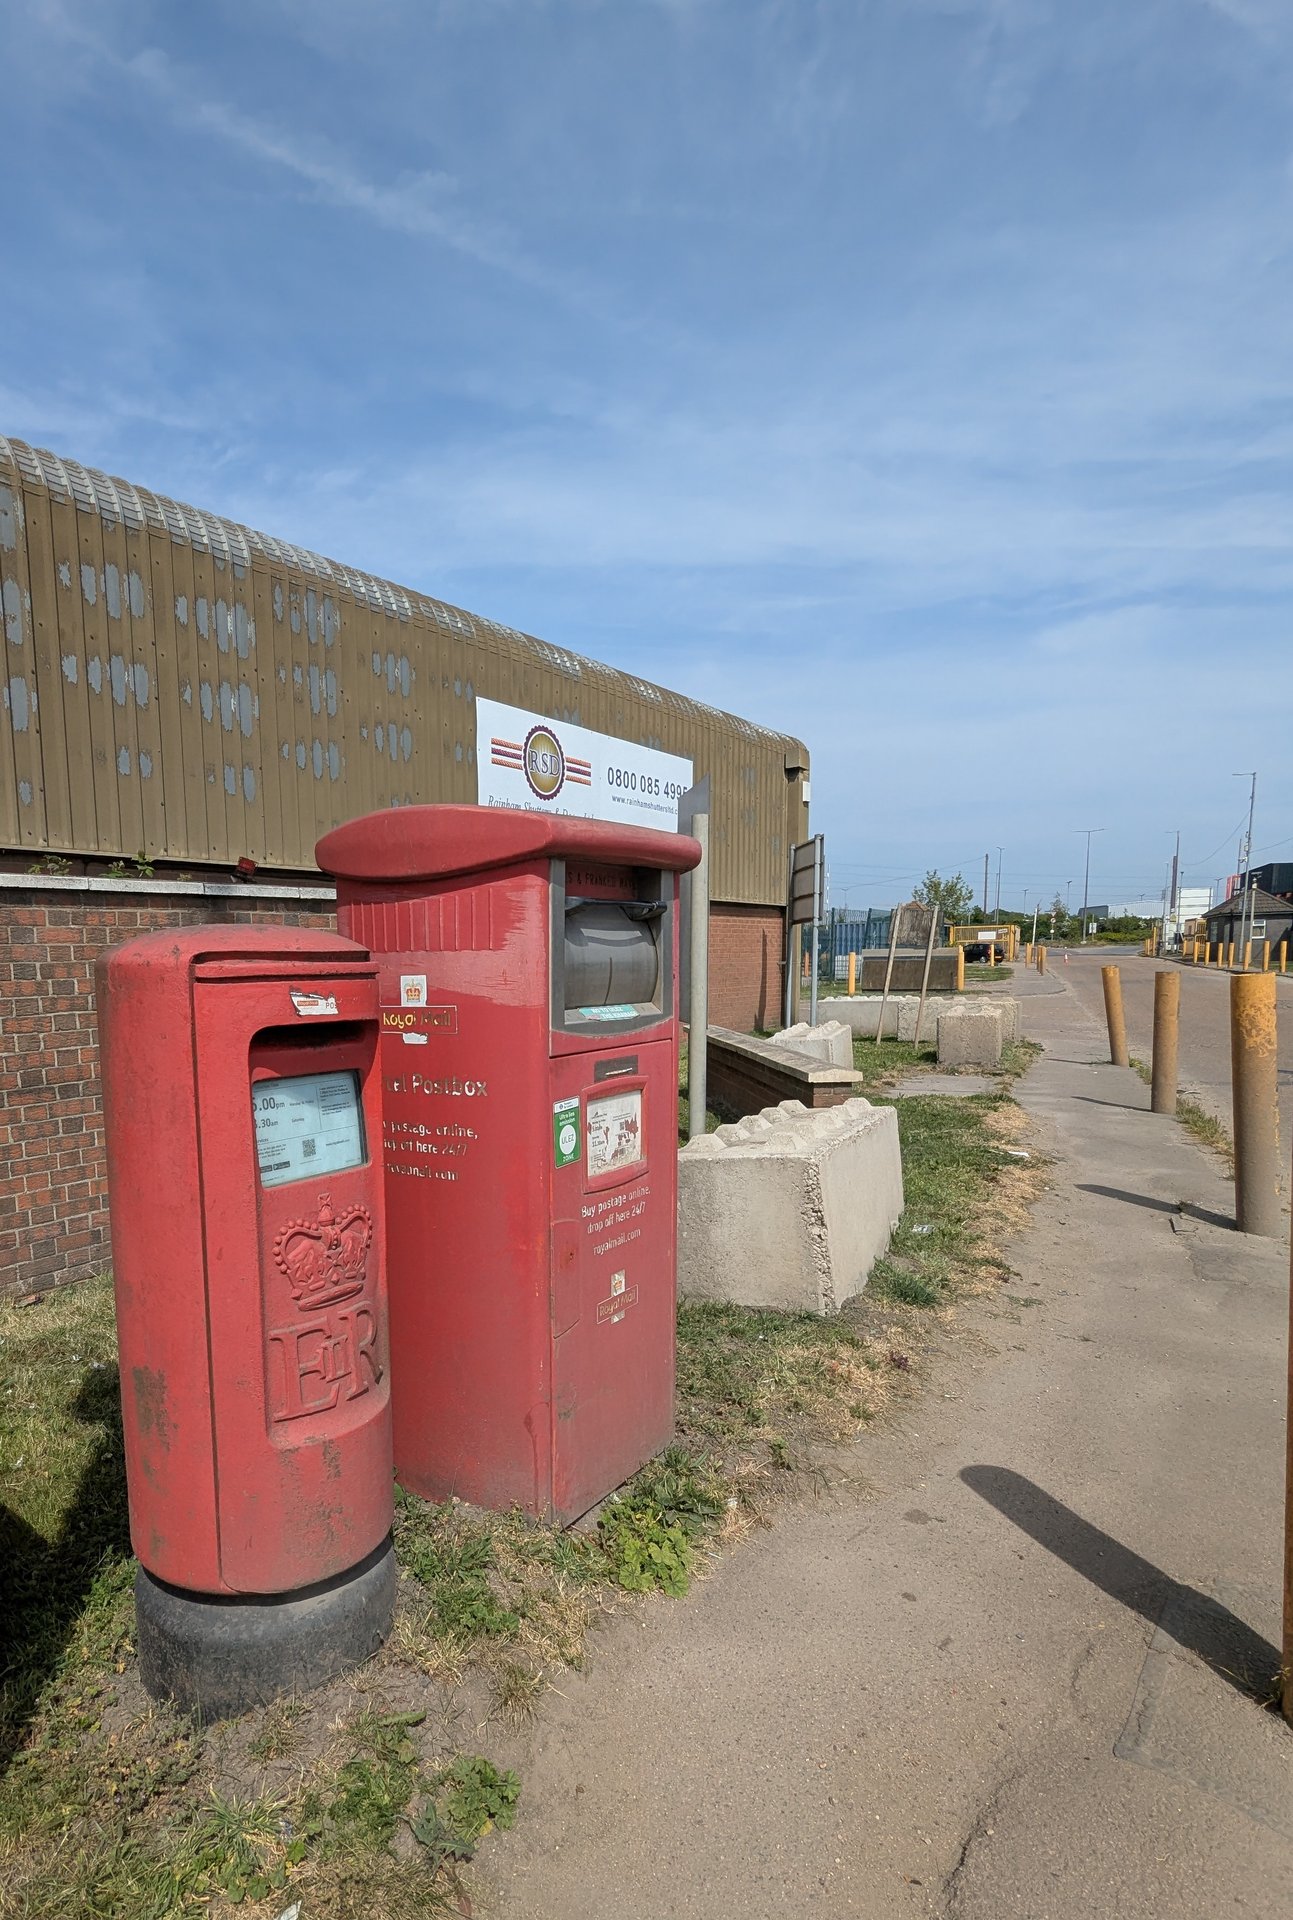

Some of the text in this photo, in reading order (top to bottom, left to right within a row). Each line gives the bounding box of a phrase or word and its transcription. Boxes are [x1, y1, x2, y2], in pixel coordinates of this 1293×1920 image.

[528, 748, 561, 777] RSD
[607, 766, 637, 791] 0800
[640, 775, 660, 796] 085
[416, 1140, 438, 1154] here
[561, 1133, 575, 1144] ULEZ
[581, 1205, 596, 1218] Buy
[598, 1194, 627, 1215] postage
[587, 1200, 646, 1234] drop off here 24/7
[593, 1228, 641, 1256] royalmail.com
